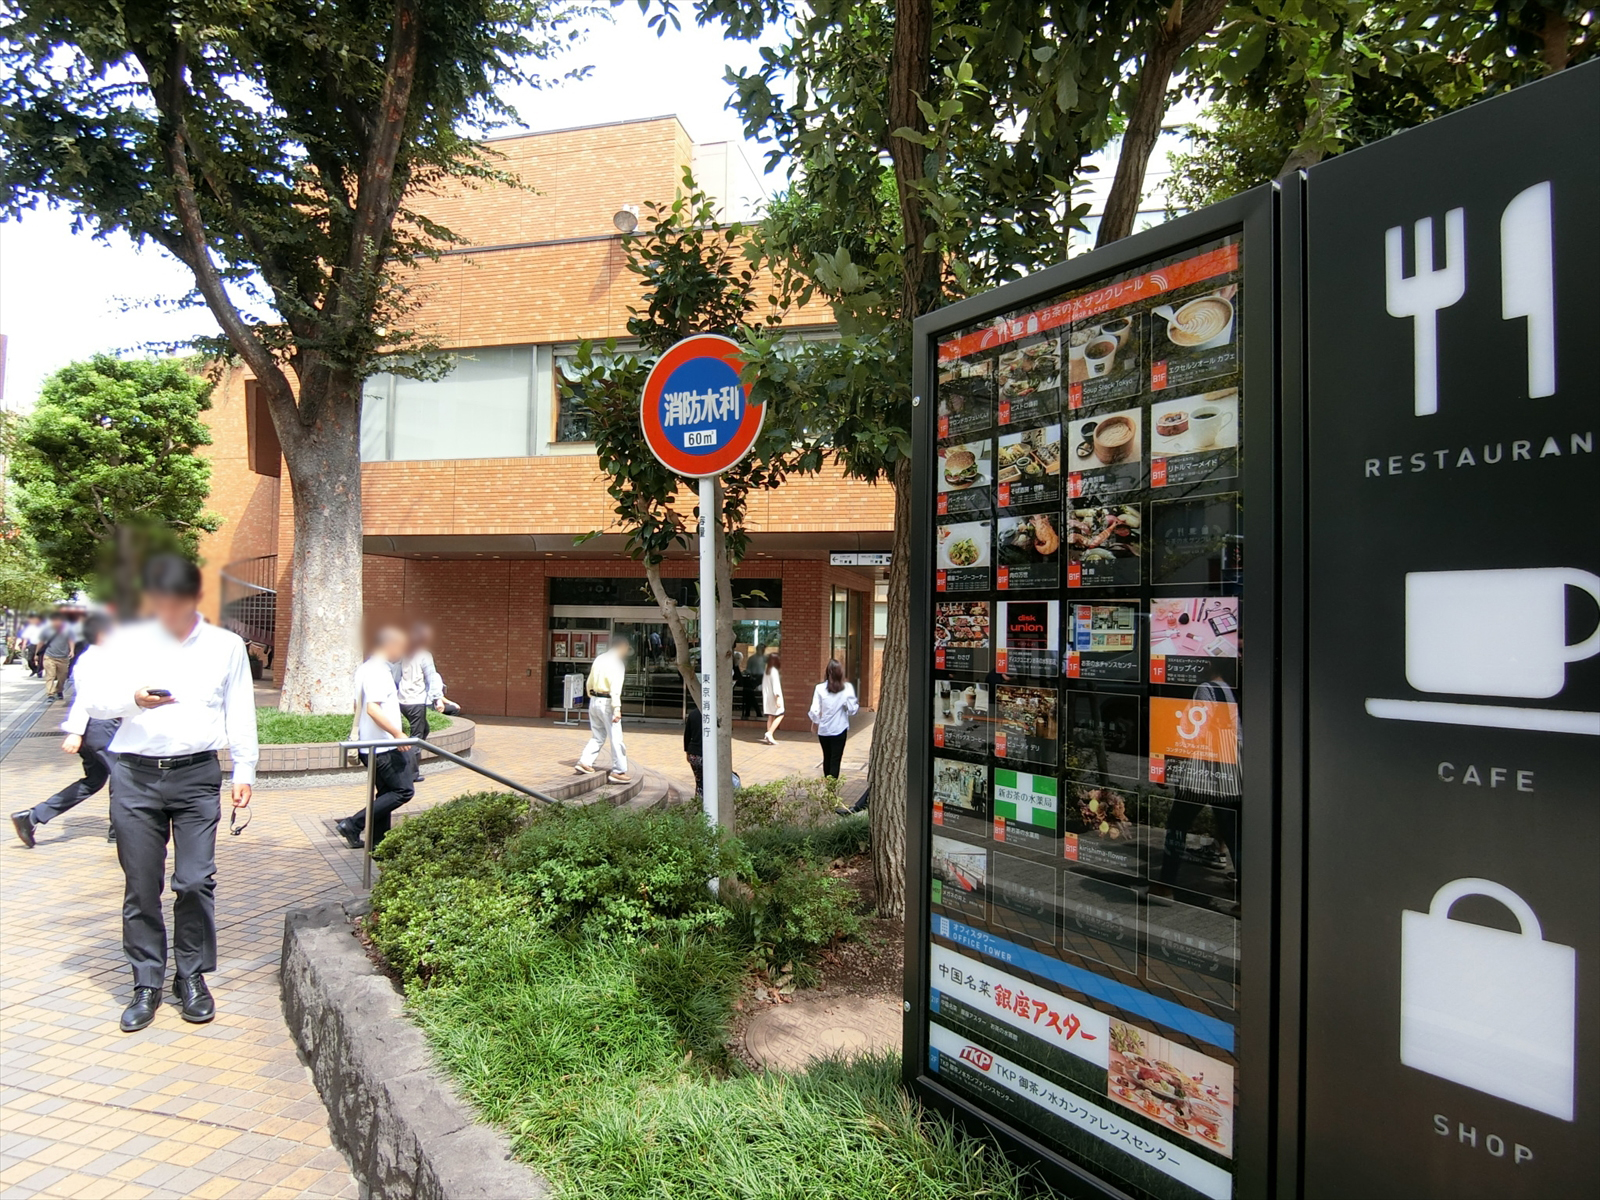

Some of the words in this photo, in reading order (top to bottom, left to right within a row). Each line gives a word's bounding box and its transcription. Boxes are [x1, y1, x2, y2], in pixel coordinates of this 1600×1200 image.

[1041, 280, 1144, 321] お茶の水サンクレール
[1071, 311, 1086, 320] SHOP
[1094, 304, 1109, 313] CAFE
[1168, 358, 1215, 374] エクセルシオール
[1217, 352, 1236, 362] カフェ
[1153, 373, 1166, 383] B1F
[1083, 386, 1097, 395] Soup
[1099, 381, 1115, 392] Stock
[1116, 378, 1133, 389] Tokyo
[664, 386, 740, 427] 消防水利
[1365, 431, 1593, 478] RESTAURAN
[1168, 457, 1218, 472] リトルマーメイド
[1153, 471, 1166, 479] B1F
[1069, 572, 1080, 581] B1F
[1018, 614, 1036, 622] disk
[1010, 623, 1044, 632] union
[998, 659, 1005, 667] 2F
[1069, 663, 1078, 671] 1F
[1167, 664, 1205, 673] ショップイン
[702, 673, 711, 738] 東京消防庁
[945, 732, 969, 742] スターバックス
[970, 735, 986, 743] コーヒー
[1151, 765, 1164, 775] B1F
[1438, 761, 1534, 792] CAFE
[998, 788, 1052, 808] 新お茶の水薬局
[1066, 844, 1077, 853] B1F
[1079, 845, 1127, 861] kirishima-flower
[953, 923, 996, 943] オフィスタワー
[953, 933, 980, 949] OFFICE
[983, 944, 1011, 961] TOWER
[938, 963, 992, 998] 中国名菜
[994, 984, 1097, 1041] 銀座アスター
[961, 1047, 991, 1067] TKP
[995, 1063, 1017, 1081] TKP
[1018, 1075, 1181, 1166] 御茶ノ水カンファレンスセンター
[1433, 1113, 1533, 1164] SHOP
